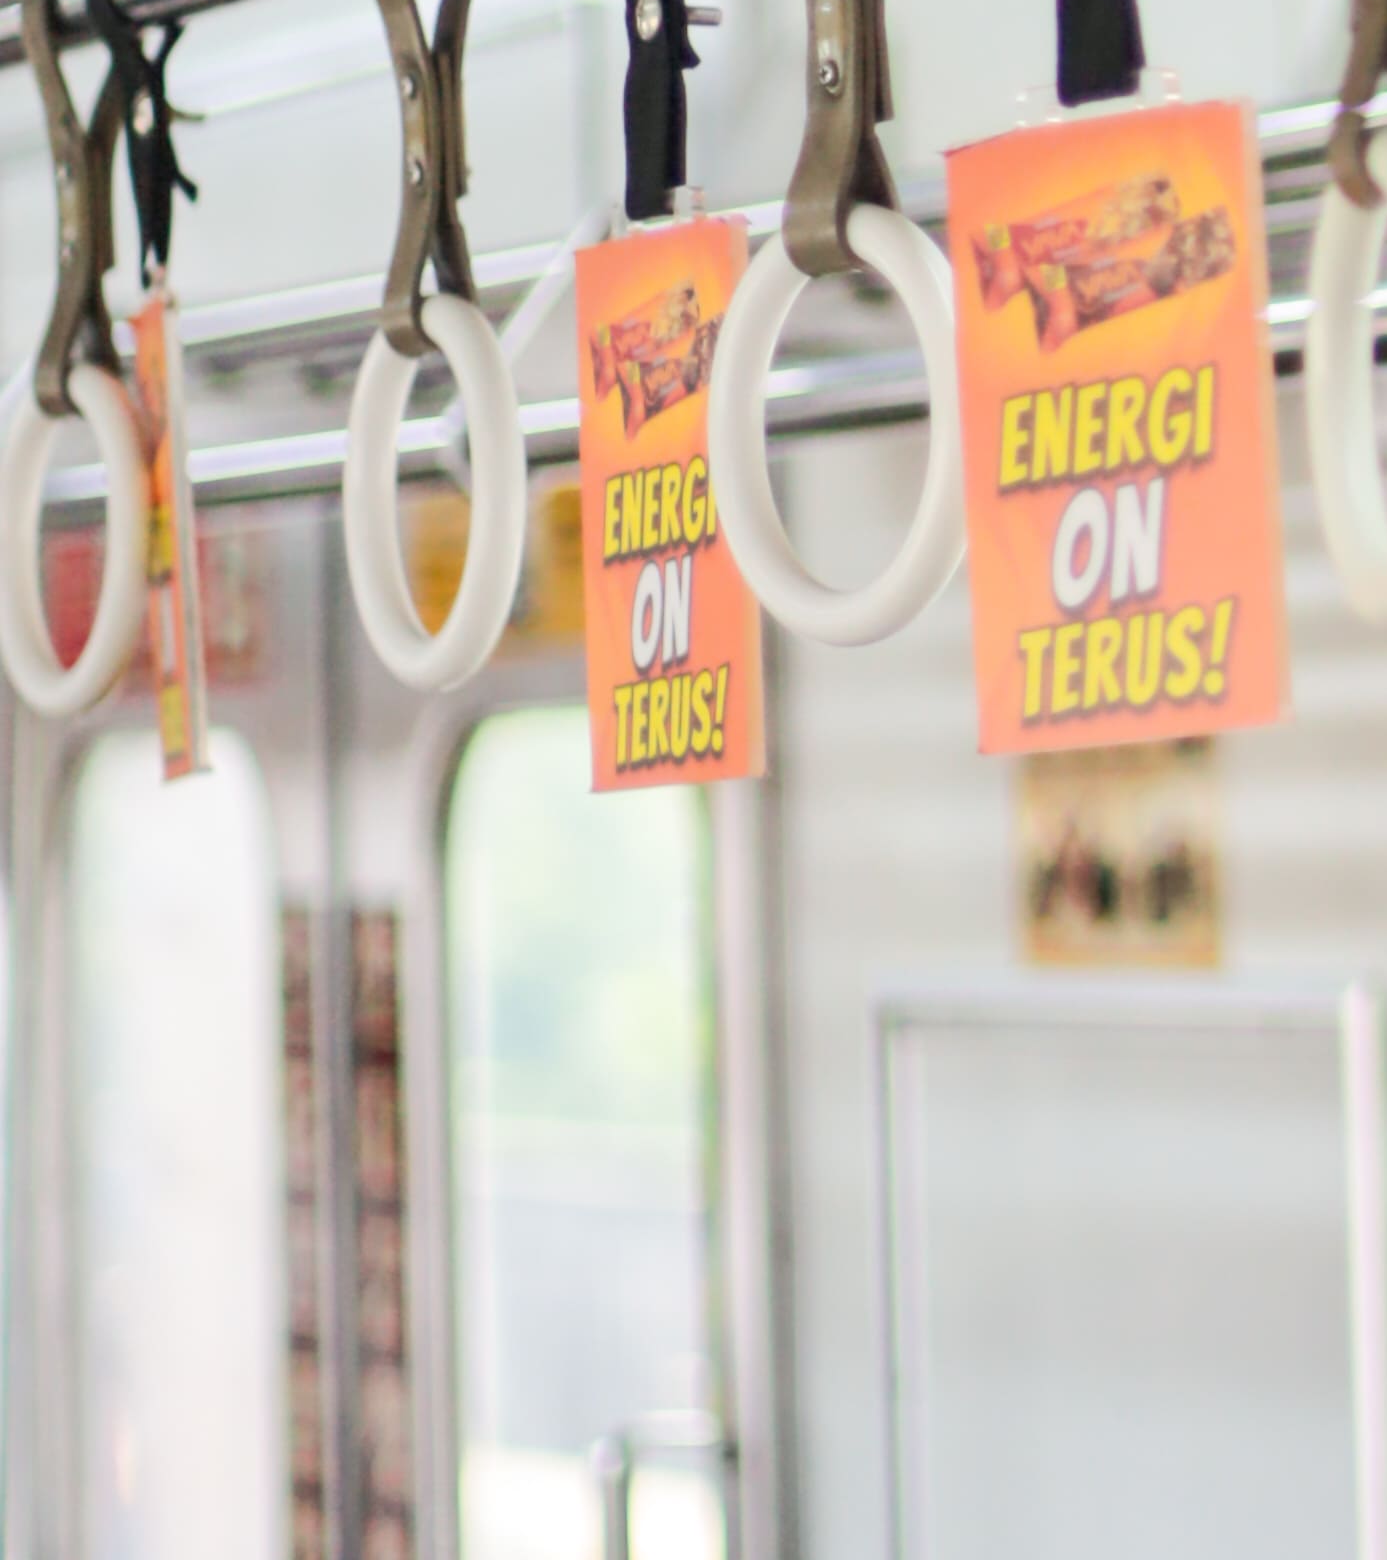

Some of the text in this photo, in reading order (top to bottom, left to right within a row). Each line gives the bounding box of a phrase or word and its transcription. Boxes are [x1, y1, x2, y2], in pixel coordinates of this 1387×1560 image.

[998, 364, 1216, 488] ENERGI
[1051, 475, 1166, 610] ON
[631, 554, 694, 672] ON
[1018, 596, 1236, 720] TERUS!
[614, 664, 729, 766] TERUS!
